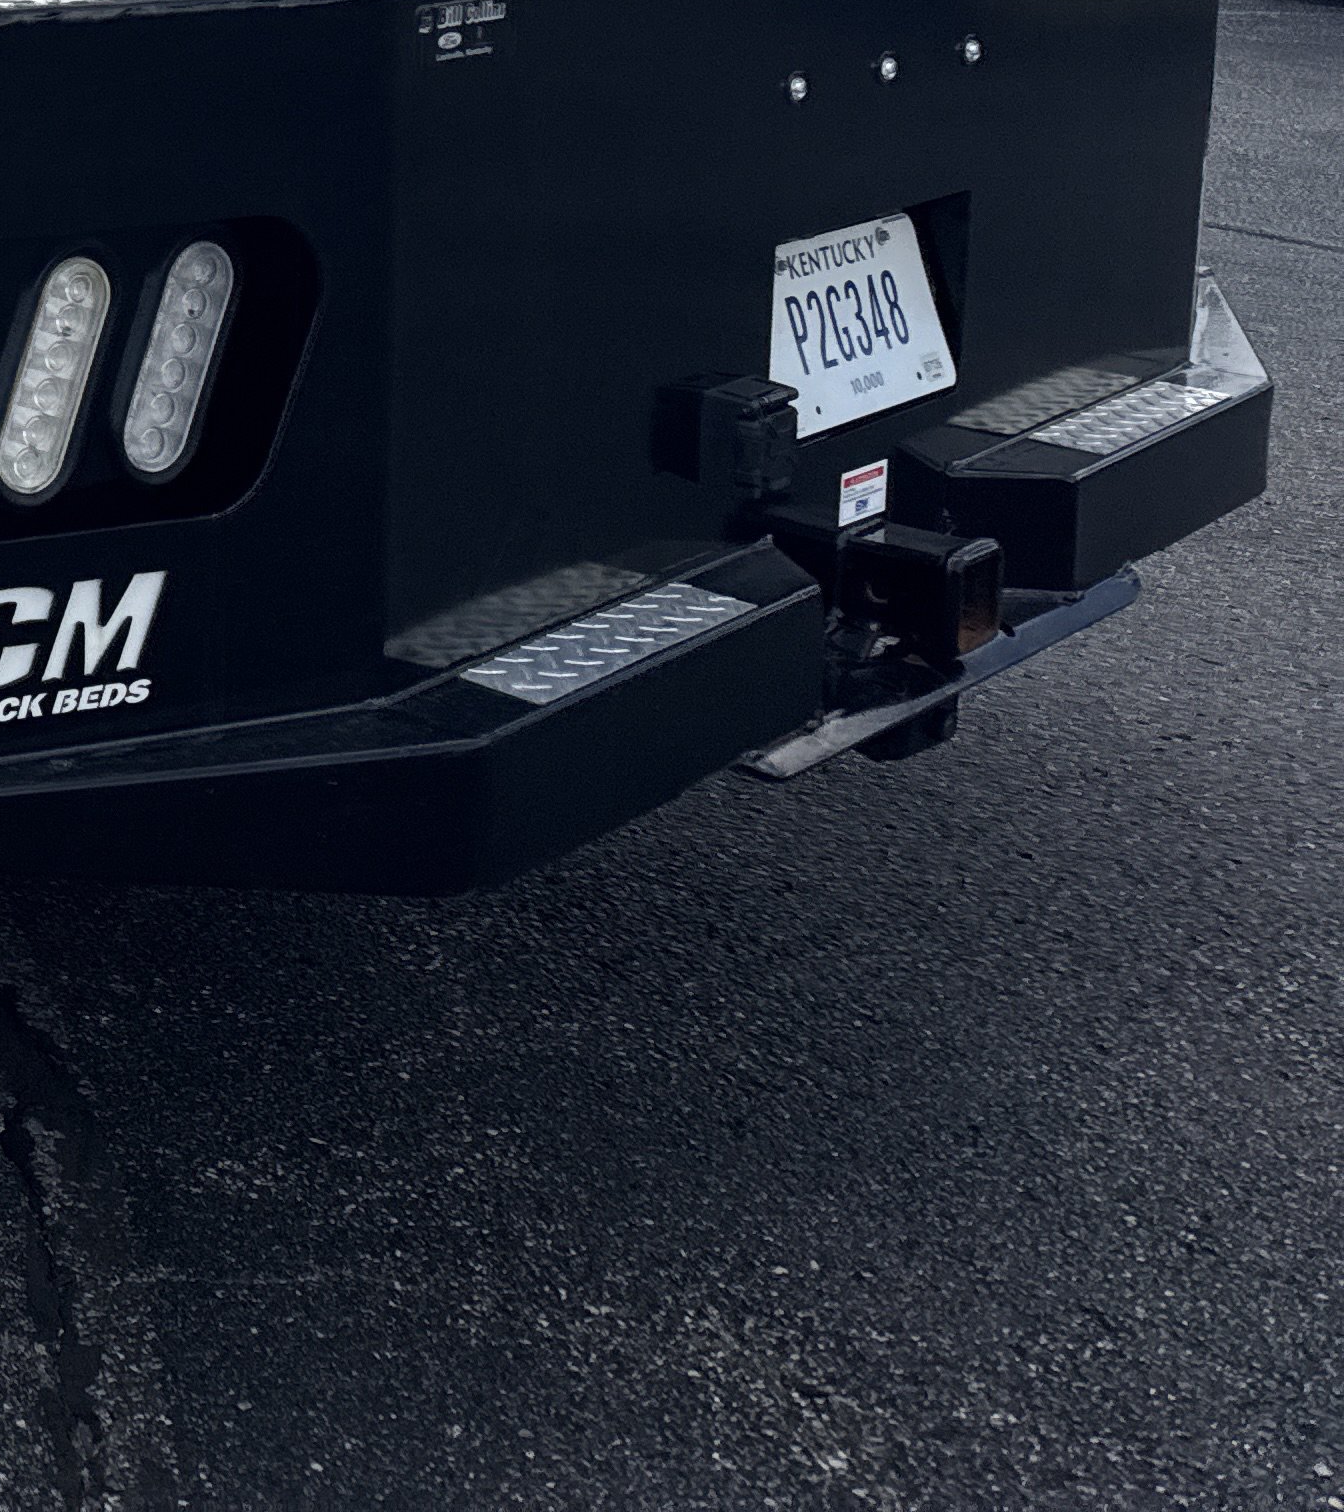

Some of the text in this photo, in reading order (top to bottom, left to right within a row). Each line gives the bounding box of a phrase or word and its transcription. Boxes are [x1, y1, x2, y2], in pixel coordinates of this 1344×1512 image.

[786, 234, 875, 280] KENTUCKY
[784, 269, 910, 376] P2G348
[849, 371, 885, 396] 10,000
[51, 678, 153, 715] BEDS
